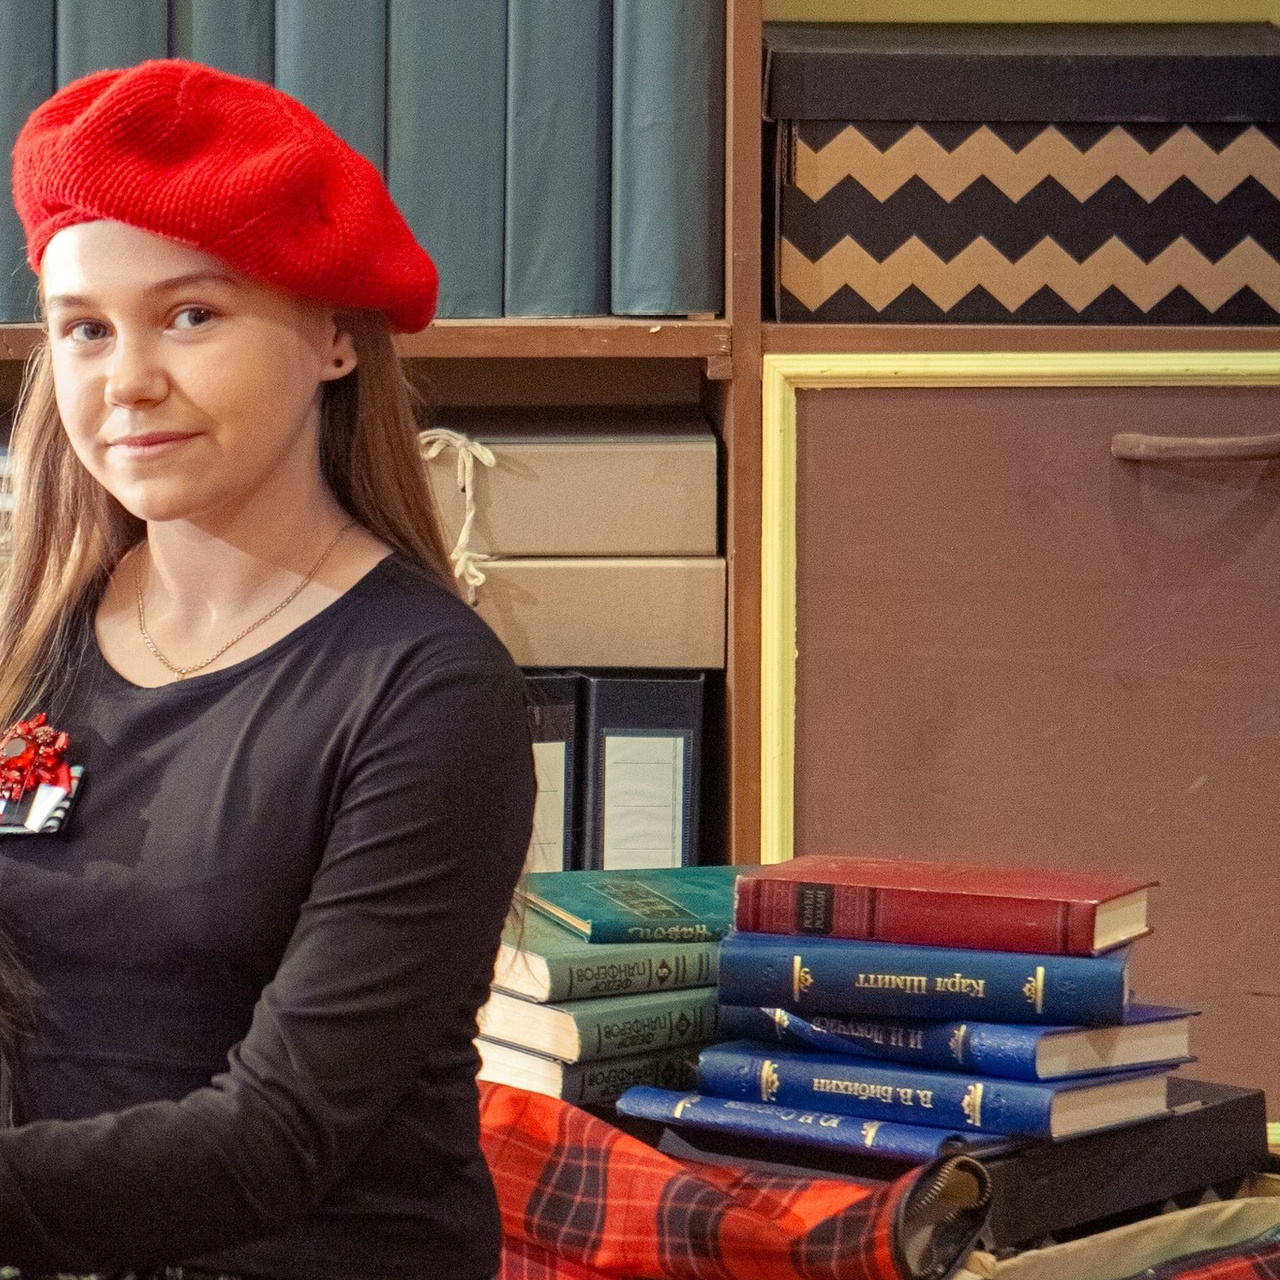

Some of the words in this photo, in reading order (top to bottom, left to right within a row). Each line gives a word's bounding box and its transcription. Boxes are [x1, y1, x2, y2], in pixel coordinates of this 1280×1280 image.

[577, 962, 646, 981] ПАНФЕРОВ
[589, 978, 631, 993] ФЕДОР
[855, 972, 927, 994] Шмитт
[935, 972, 985, 997] Карл
[604, 1015, 666, 1038] ПАНФЕРОВ
[812, 1077, 893, 1103] Бибихин
[896, 1088, 912, 1107] В.
[917, 1089, 933, 1109] В.
